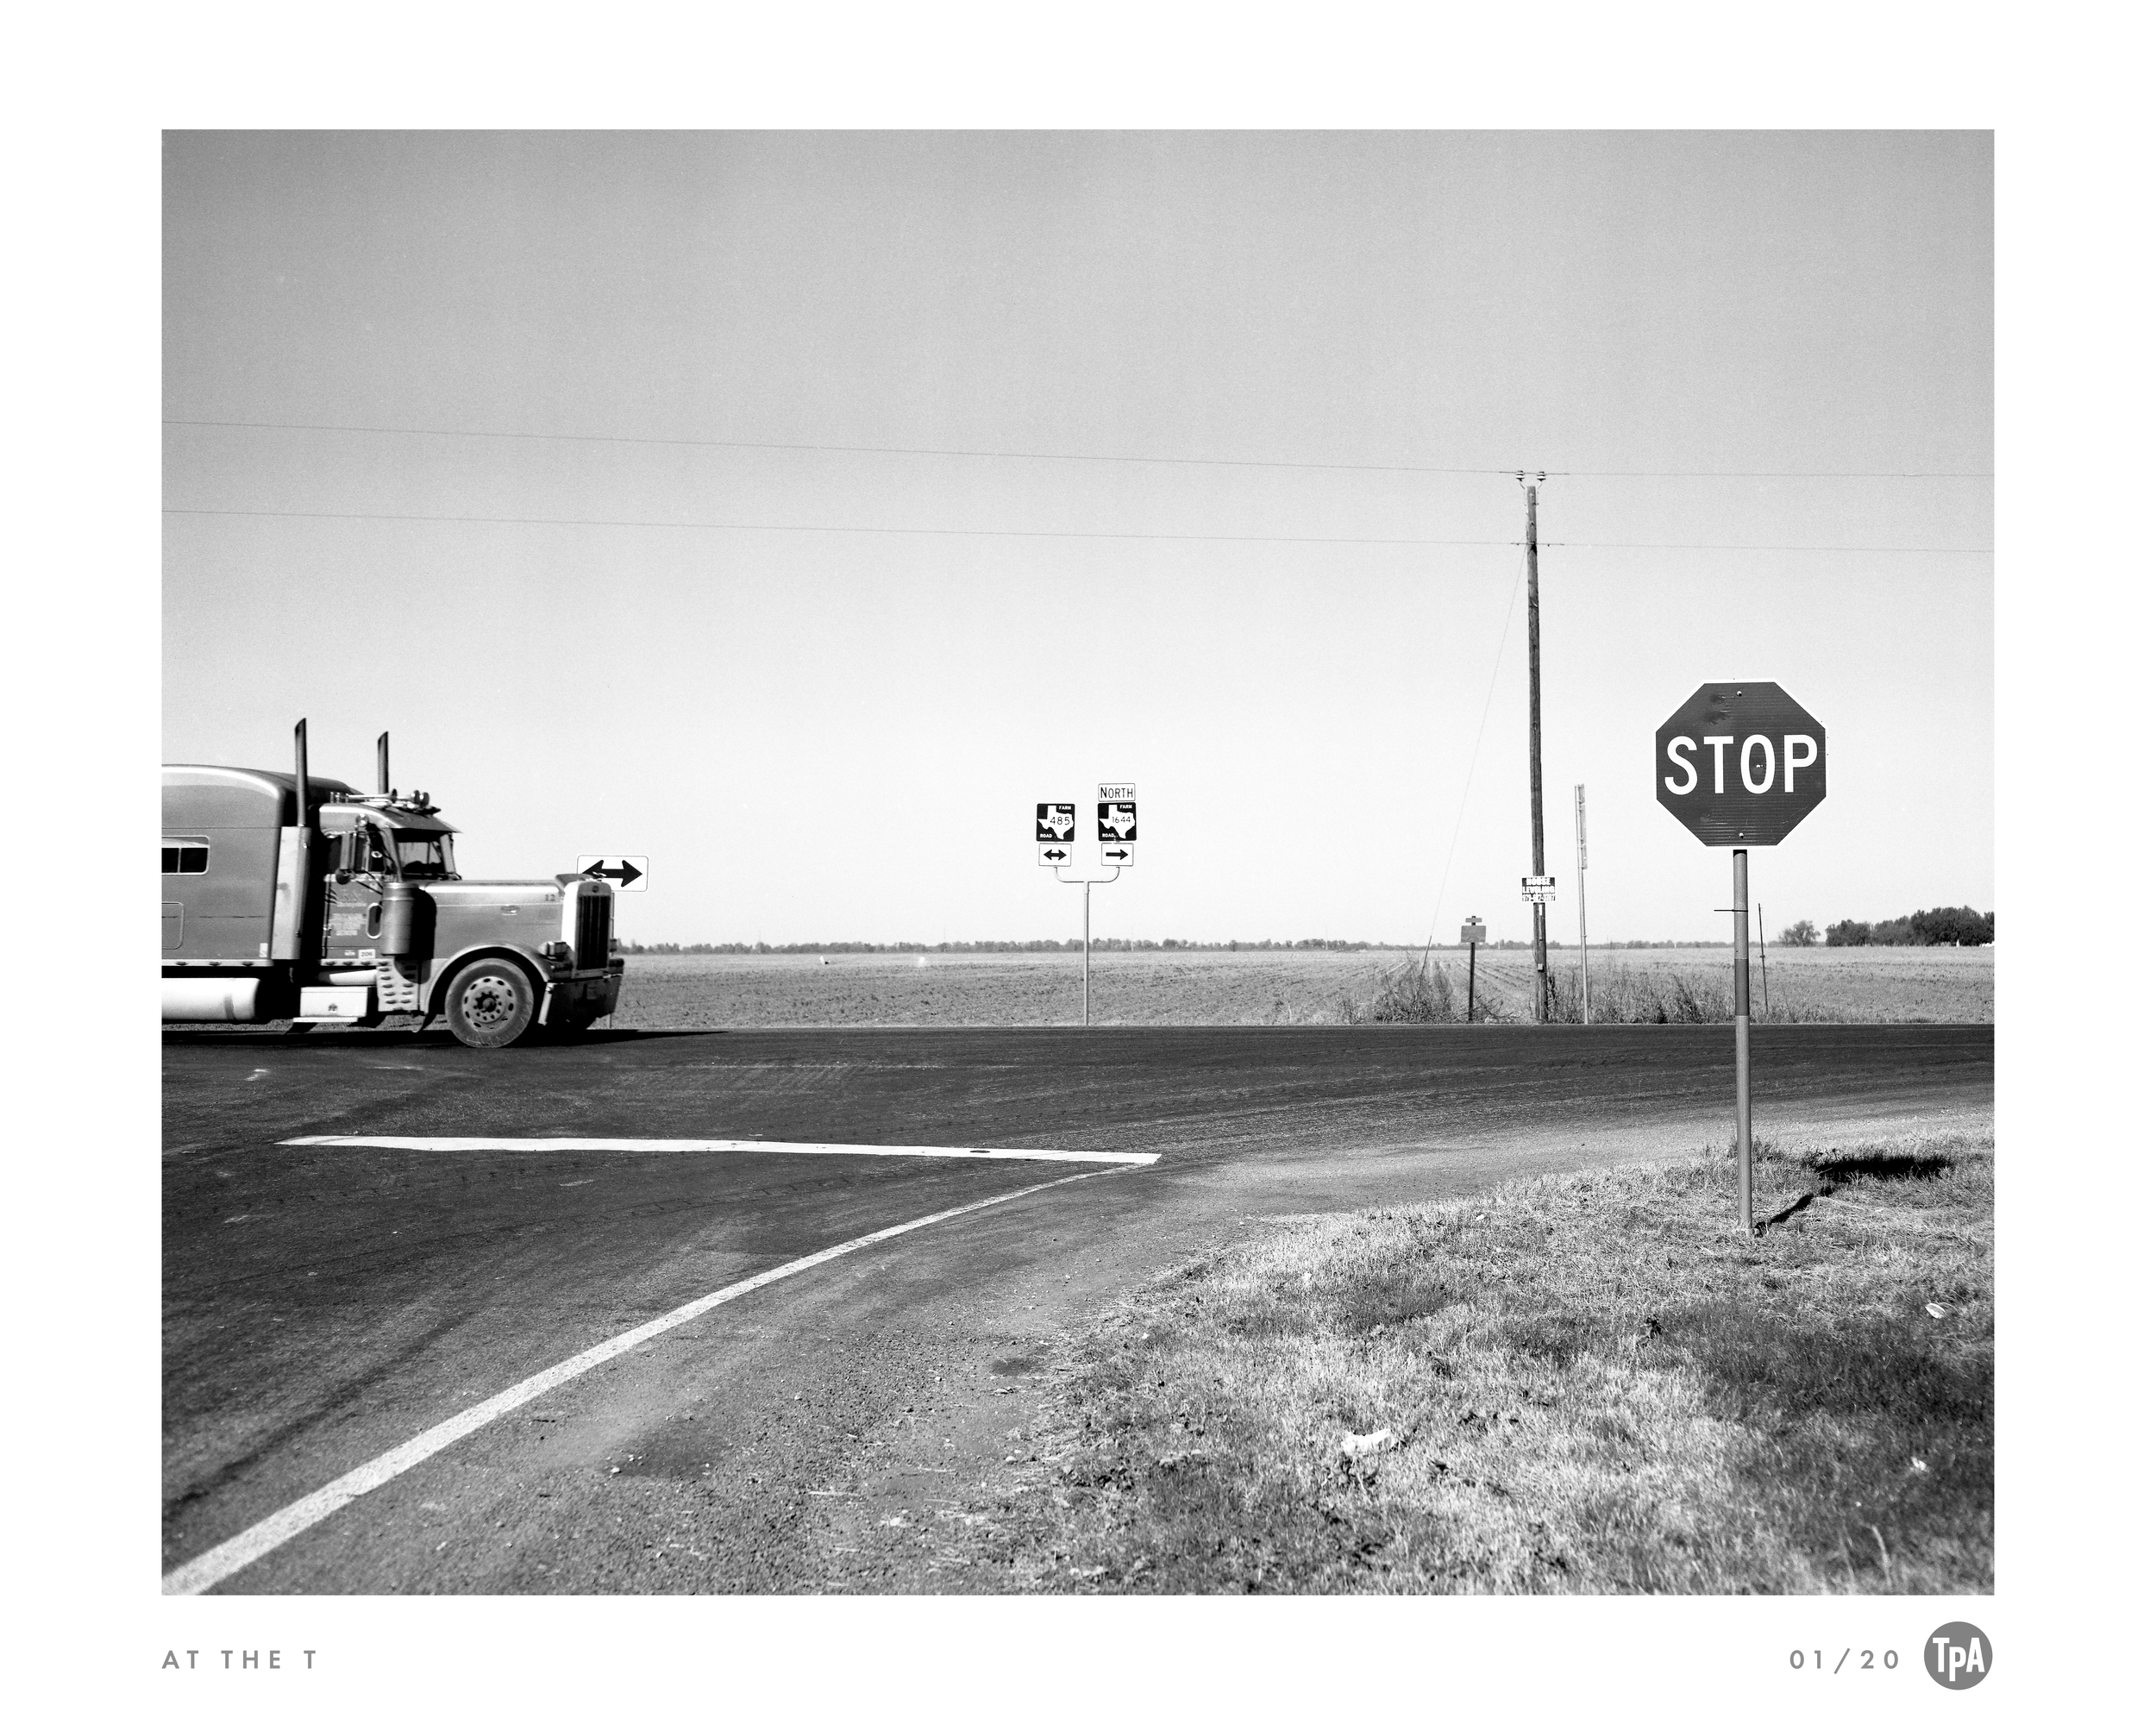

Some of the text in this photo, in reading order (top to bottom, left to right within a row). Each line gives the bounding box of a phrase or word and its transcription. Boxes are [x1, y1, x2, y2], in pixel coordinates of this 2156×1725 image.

[1664, 734, 1818, 795] STOP
[1100, 787, 1133, 799] NORTH
[1050, 816, 1070, 825] 485
[1526, 877, 1551, 886] HOUSE
[545, 894, 556, 902] 12
